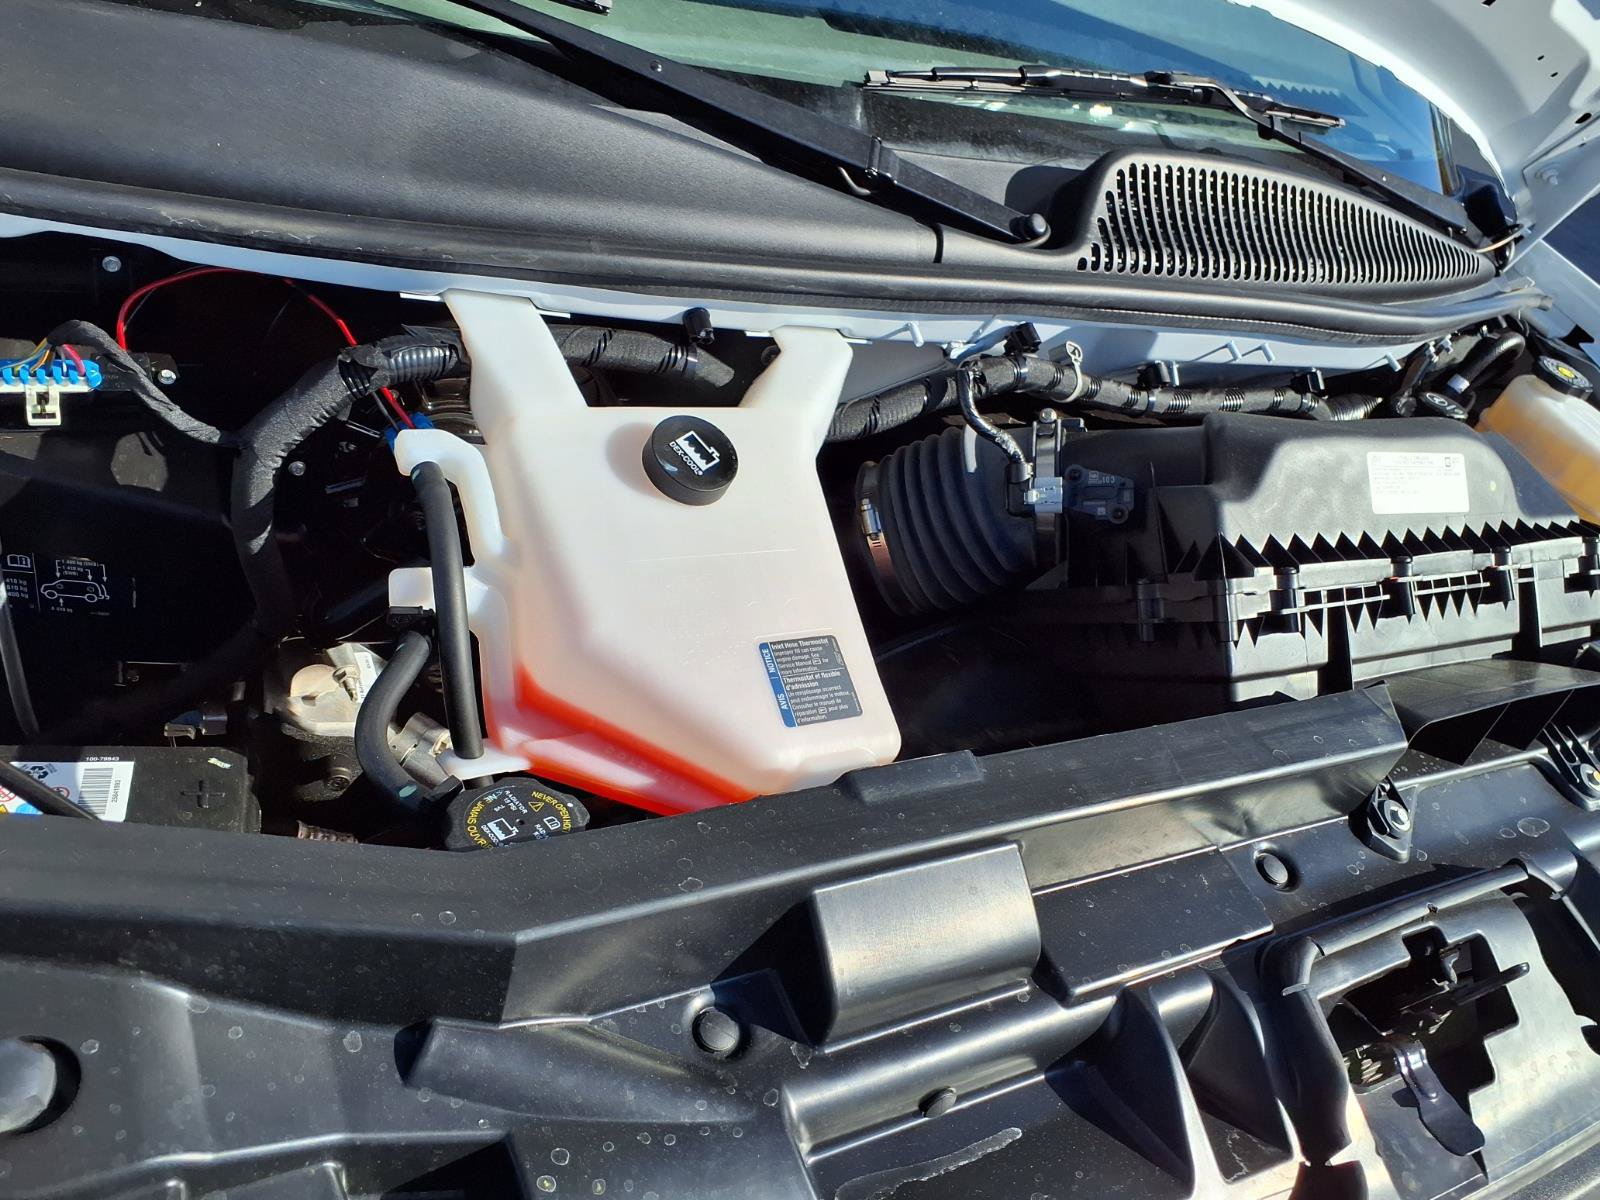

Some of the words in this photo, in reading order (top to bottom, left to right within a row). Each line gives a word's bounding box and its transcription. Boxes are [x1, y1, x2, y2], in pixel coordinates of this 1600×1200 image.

[798, 638, 829, 647] Thermostat
[762, 648, 776, 673] NOTICE
[782, 674, 814, 684] Thermostat
[778, 693, 789, 710] AVIS
[467, 800, 485, 824] JAMAIS
[505, 790, 528, 815] RADIATOR
[531, 790, 557, 806] NEVER
[555, 803, 571, 821] OPEN
